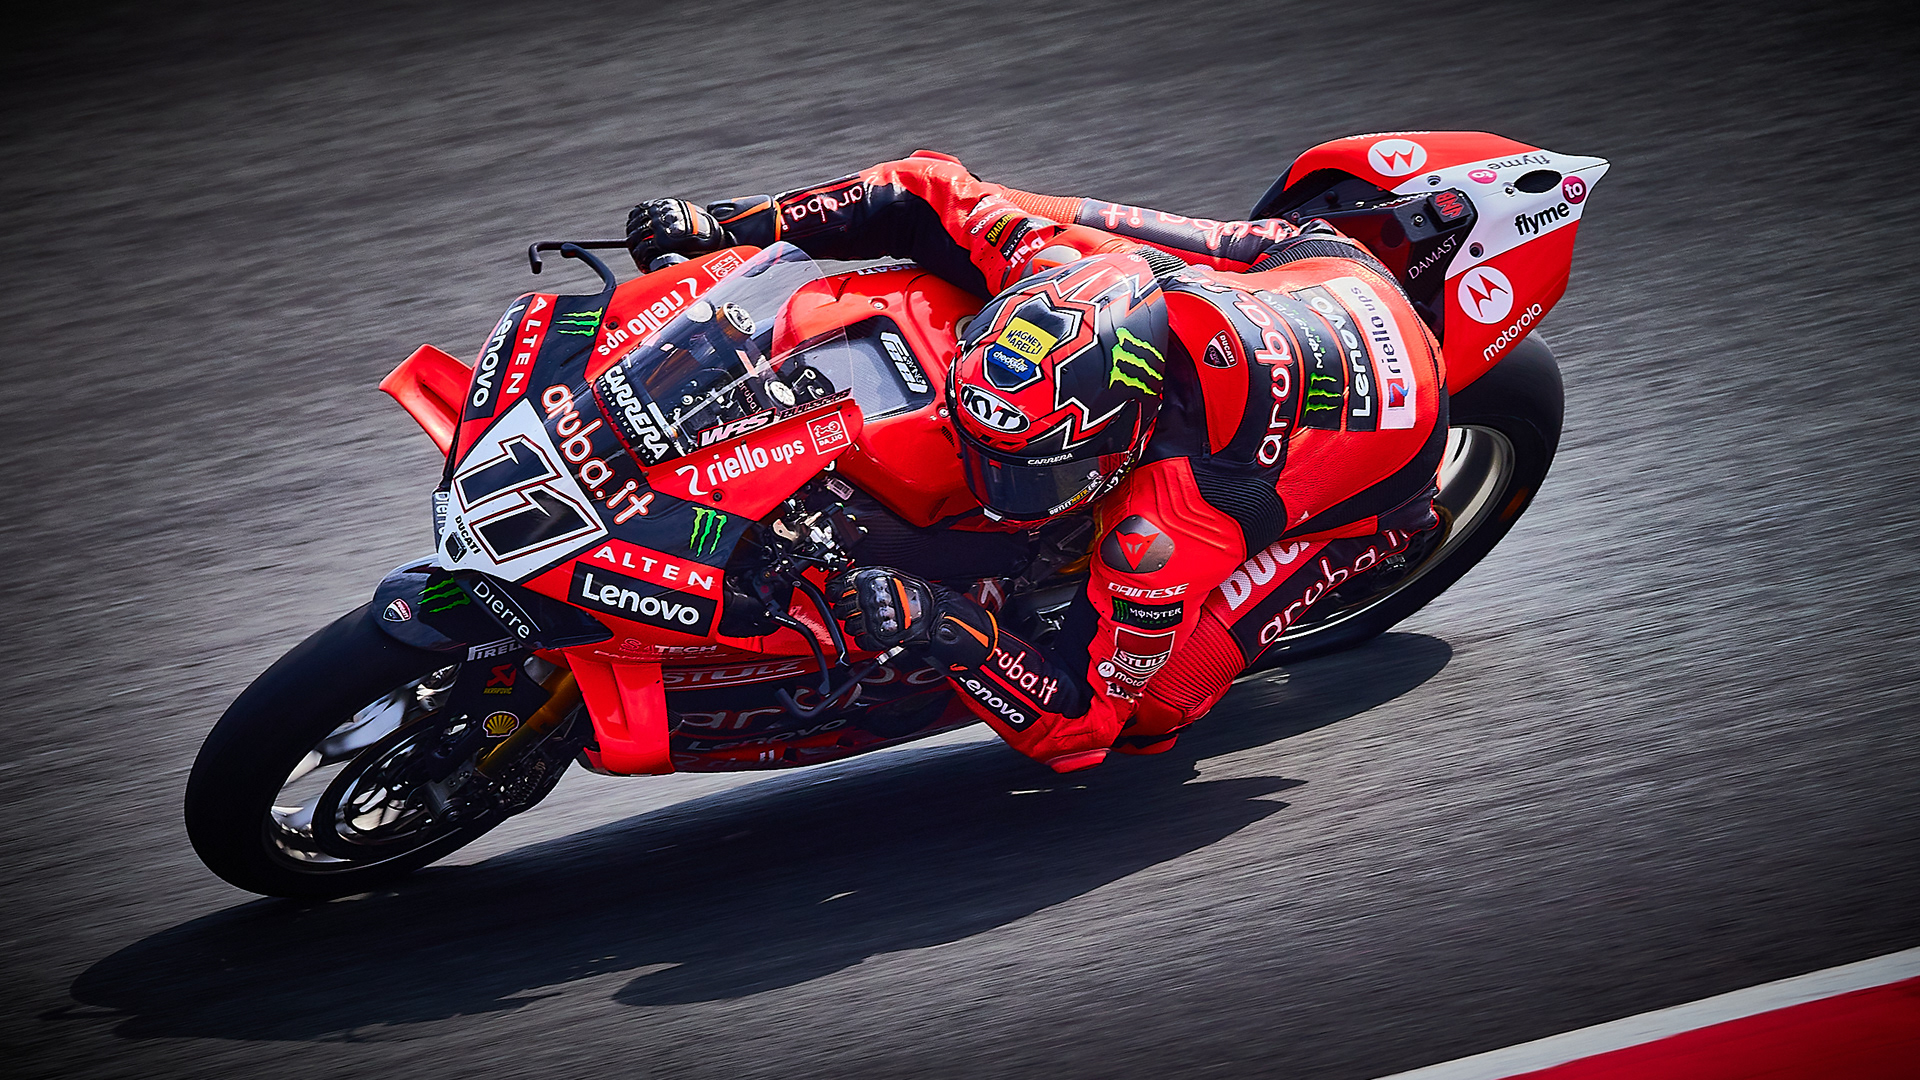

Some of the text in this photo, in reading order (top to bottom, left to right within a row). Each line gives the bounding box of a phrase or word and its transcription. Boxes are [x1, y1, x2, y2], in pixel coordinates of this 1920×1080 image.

[1472, 170, 1493, 180] to
[1488, 154, 1550, 170] flyme
[781, 186, 863, 231] aruba.i
[1565, 182, 1583, 198] to
[1514, 202, 1571, 236] flyme
[1408, 234, 1458, 280] DAMAST
[506, 296, 547, 394] ALTEN
[597, 291, 684, 356] riello ups
[1351, 286, 1401, 374] riello ups
[1482, 302, 1543, 361] motorola
[473, 303, 526, 407] Lenovo
[1220, 335, 1235, 363] DUCATI
[1310, 296, 1371, 417] Lenovo
[604, 365, 669, 460] CARRERA
[738, 381, 762, 413] aruba.i
[970, 394, 1019, 428] KYT
[701, 410, 773, 447] WRS
[541, 384, 654, 524] aruba.it
[706, 439, 805, 486] riello ups
[1028, 452, 1073, 466] CARRERA
[454, 434, 601, 565] 11
[455, 515, 481, 554] DUCATI
[593, 546, 713, 590] ALTEN
[1219, 541, 1310, 611] DUC
[473, 581, 530, 639] Dierre
[582, 573, 699, 625] Lenovo
[1108, 582, 1190, 599] DAINESE
[1129, 607, 1182, 620] MONSTER
[467, 637, 523, 661] PIREL
[1119, 651, 1167, 668] STULZ
[663, 661, 802, 684] STULZ
[992, 647, 1058, 705] ruba.it
[1115, 672, 1148, 687] moto
